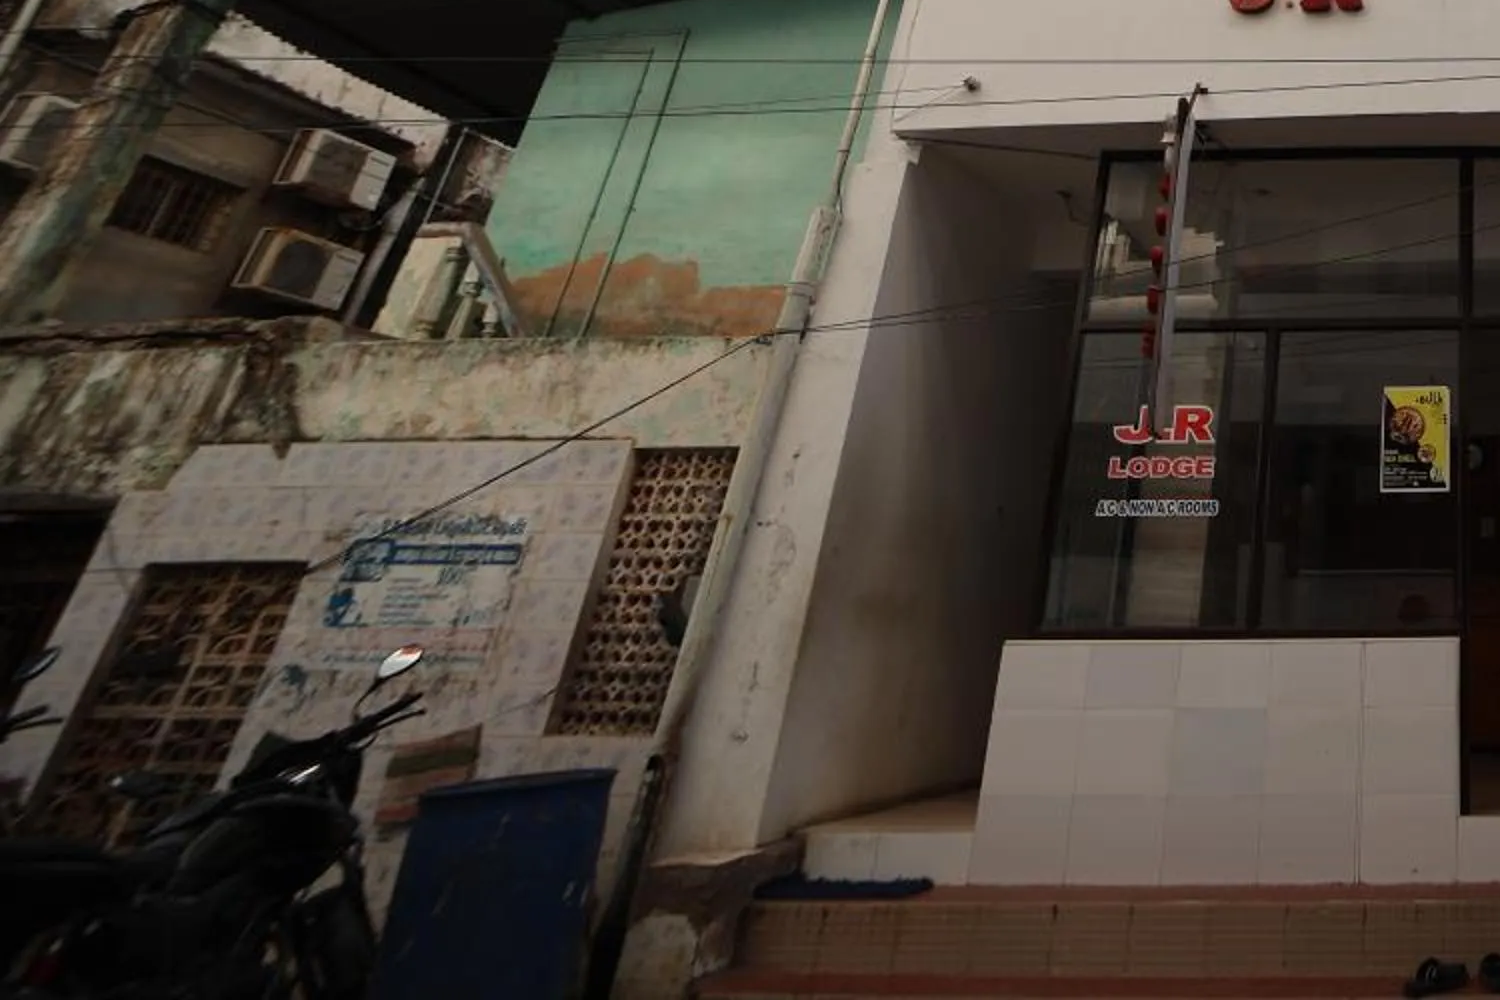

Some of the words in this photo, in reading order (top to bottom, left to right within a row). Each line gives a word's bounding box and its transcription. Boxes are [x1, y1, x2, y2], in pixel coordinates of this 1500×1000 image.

[1107, 456, 1217, 480] LODGE
[1129, 499, 1156, 516] NON
[1177, 499, 1220, 516] ROOMS
